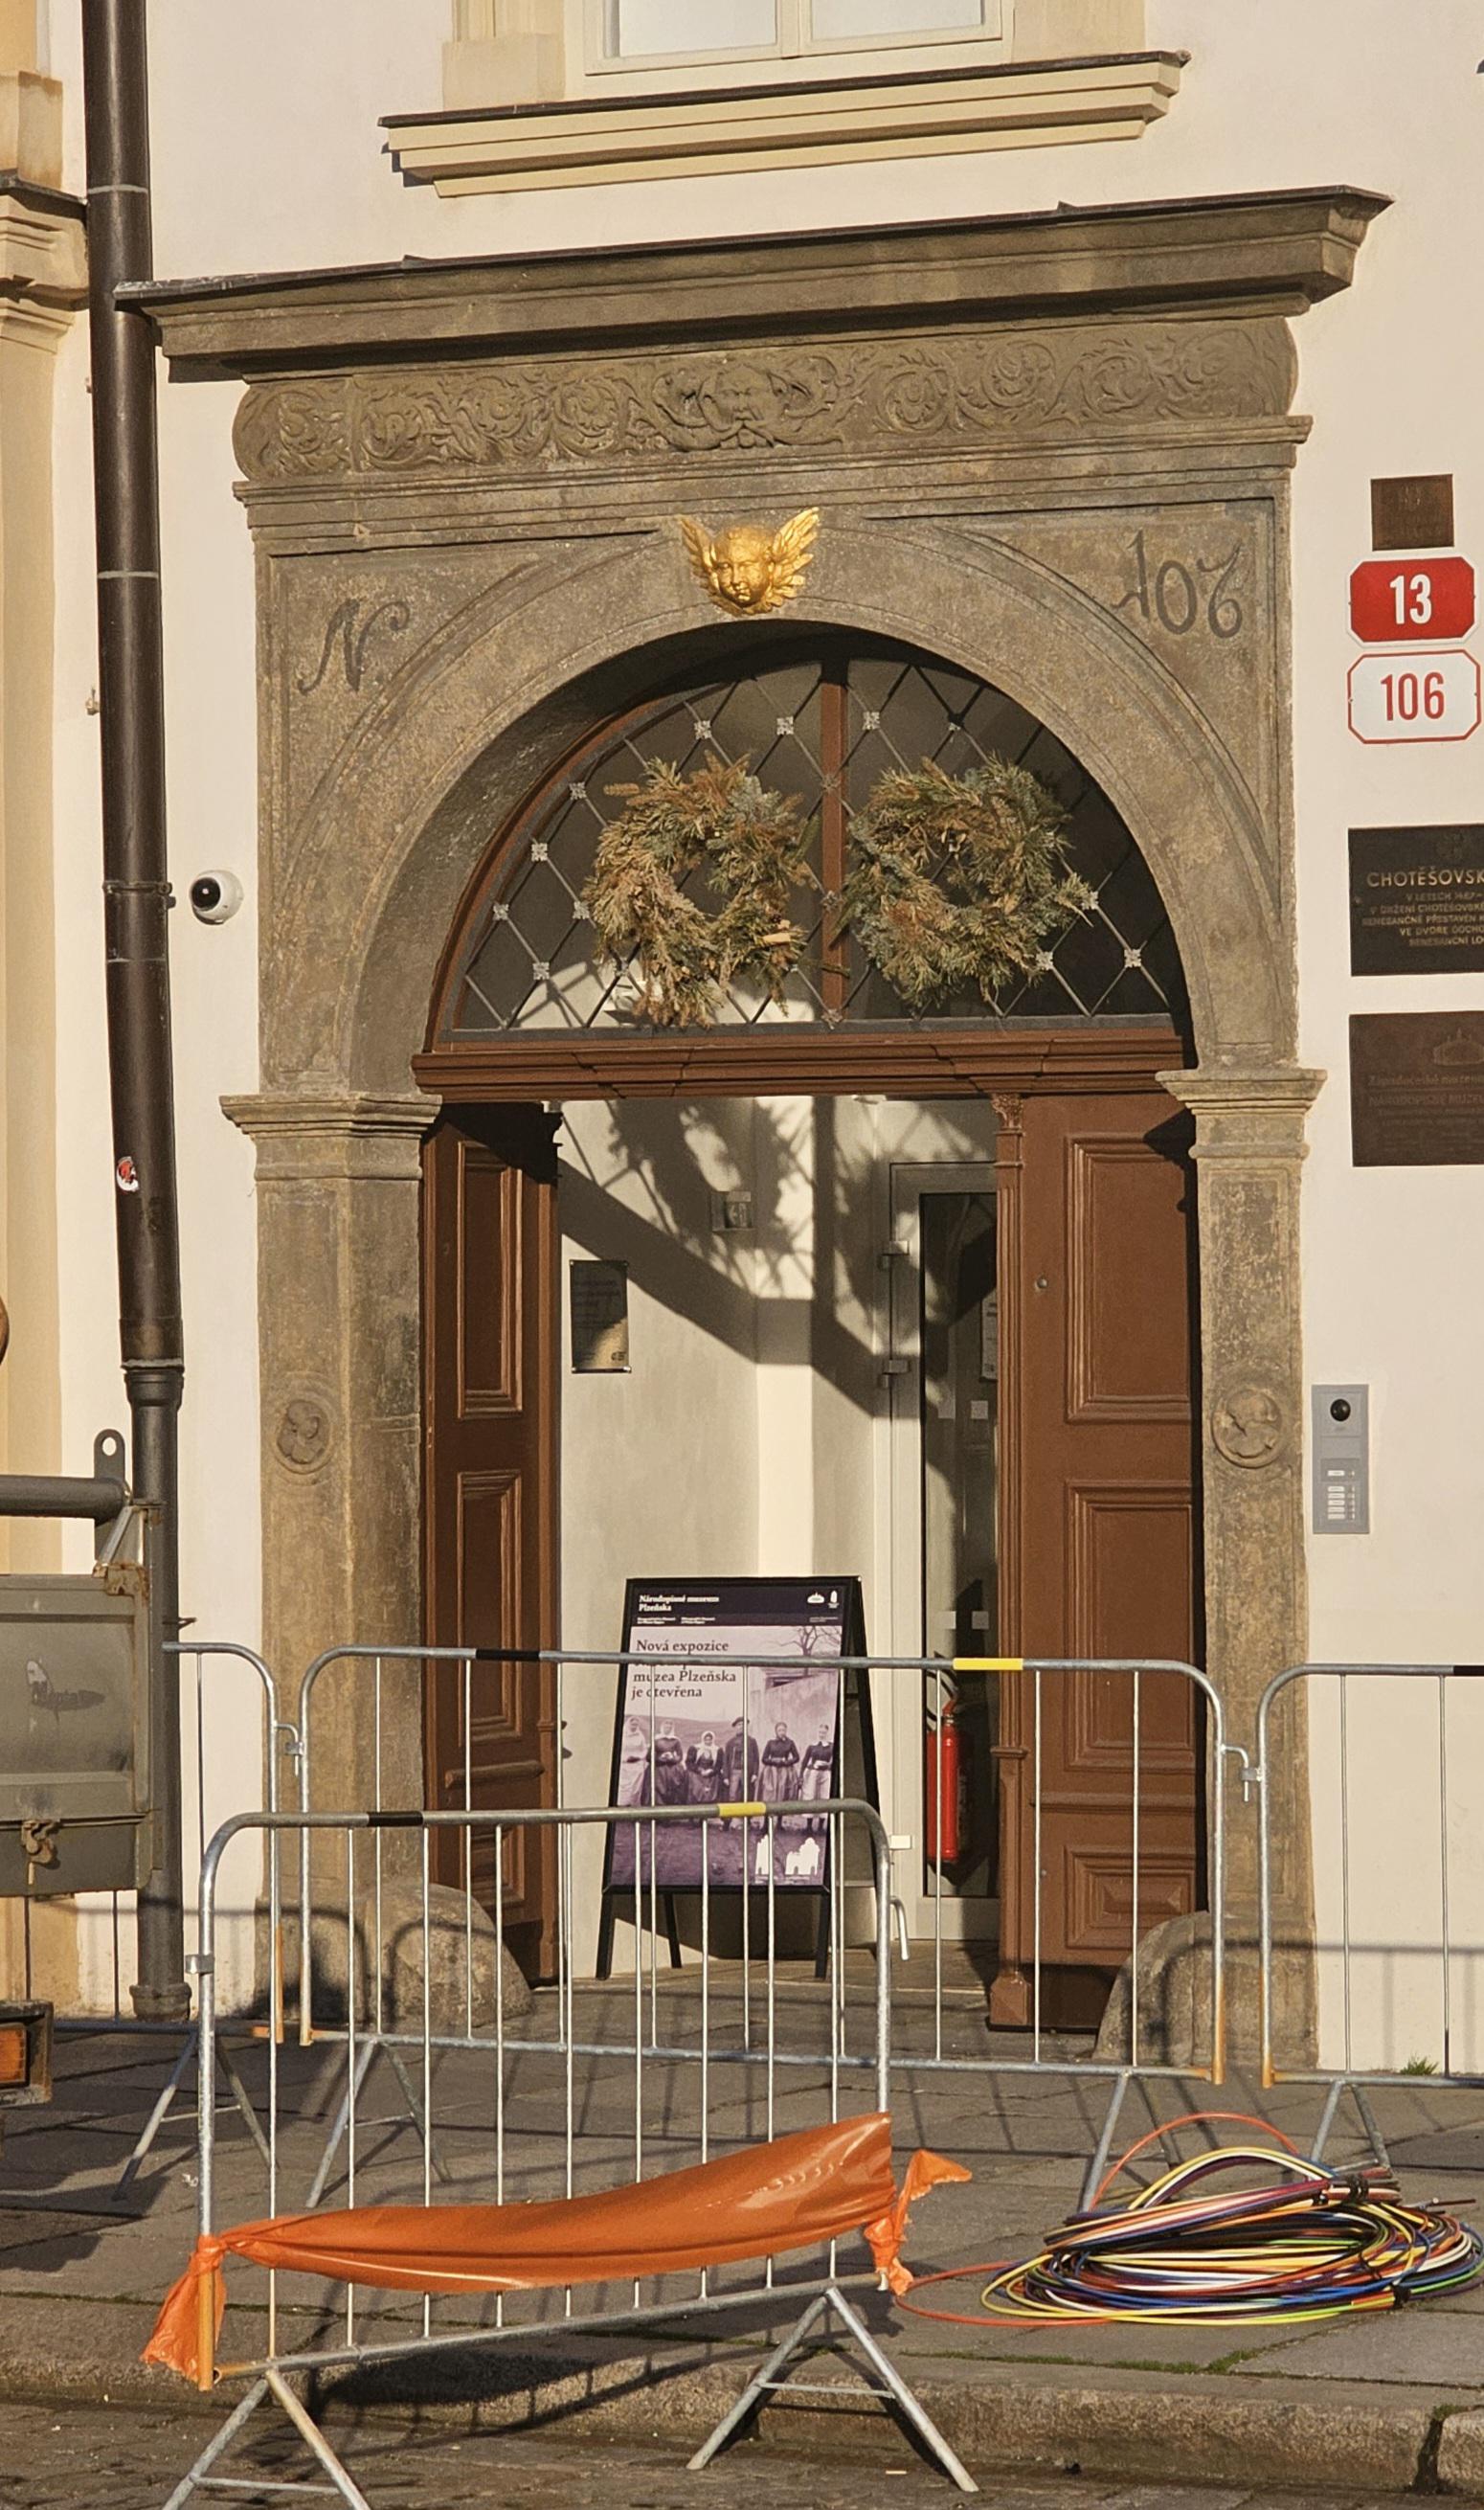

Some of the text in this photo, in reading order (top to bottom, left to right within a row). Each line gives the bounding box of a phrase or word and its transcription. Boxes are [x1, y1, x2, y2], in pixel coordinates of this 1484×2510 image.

[1112, 528, 1244, 639] 106
[1389, 574, 1432, 625] 13
[1380, 671, 1446, 721] 106
[636, 1639, 729, 1655] Nová expozice
[679, 1669, 736, 1683] Plzeňska
[631, 1686, 643, 1700] je
